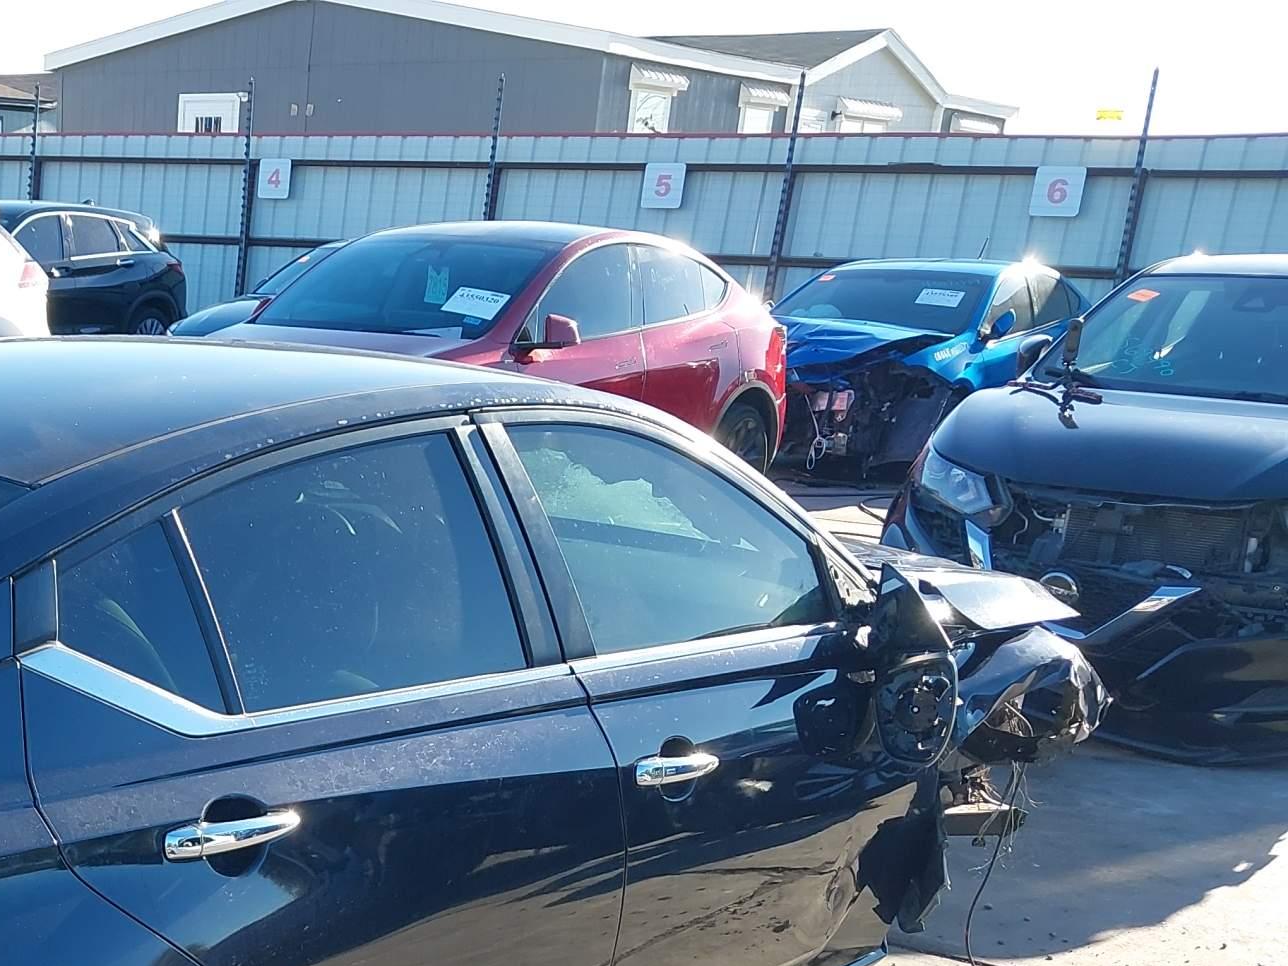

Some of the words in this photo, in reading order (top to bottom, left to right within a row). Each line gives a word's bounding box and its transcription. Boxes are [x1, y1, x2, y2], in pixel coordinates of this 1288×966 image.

[267, 168, 281, 188] 4
[654, 174, 672, 197] 5
[1047, 178, 1069, 205] 6
